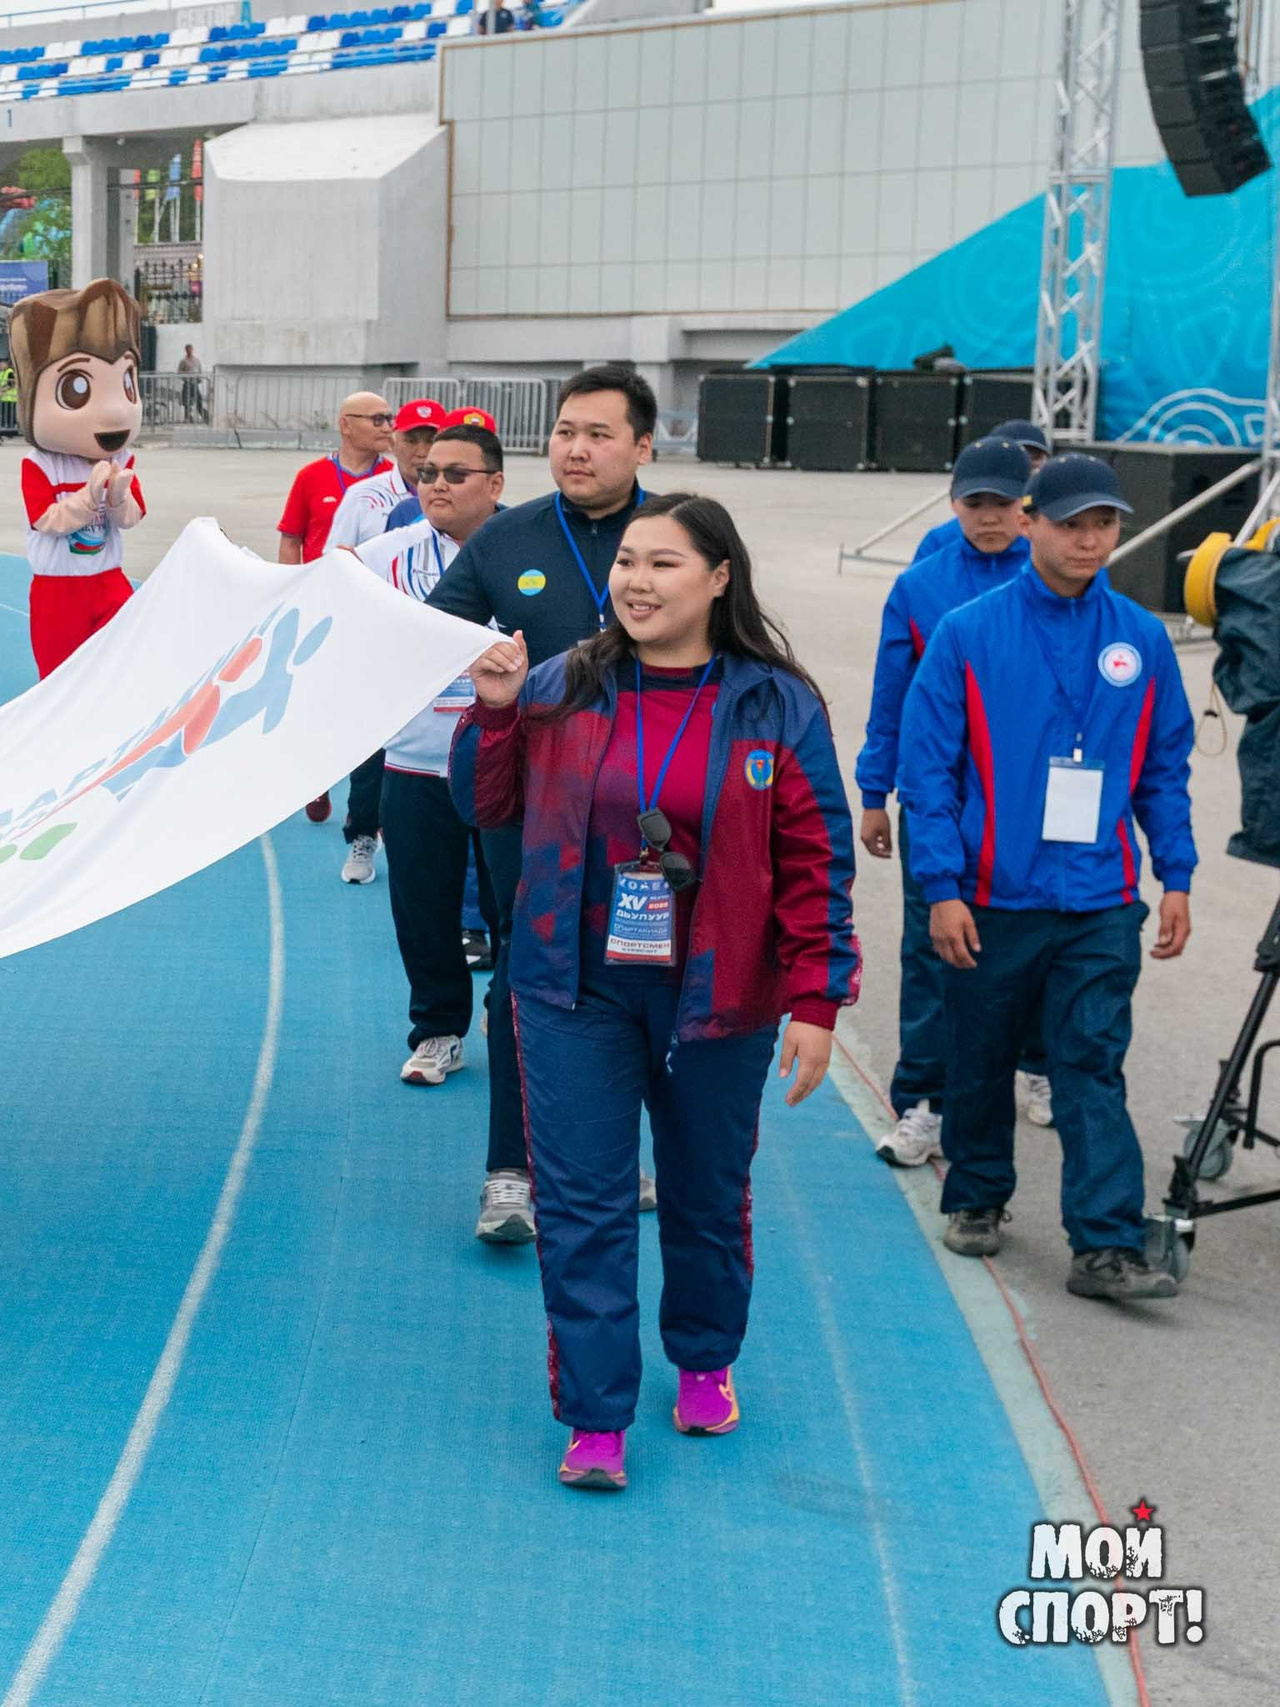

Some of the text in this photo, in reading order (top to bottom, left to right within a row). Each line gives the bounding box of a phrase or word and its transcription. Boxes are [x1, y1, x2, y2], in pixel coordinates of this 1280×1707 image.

[6, 108, 13, 128] 1
[618, 893, 648, 910] XV
[610, 938, 670, 949] СПОРТСМЕН
